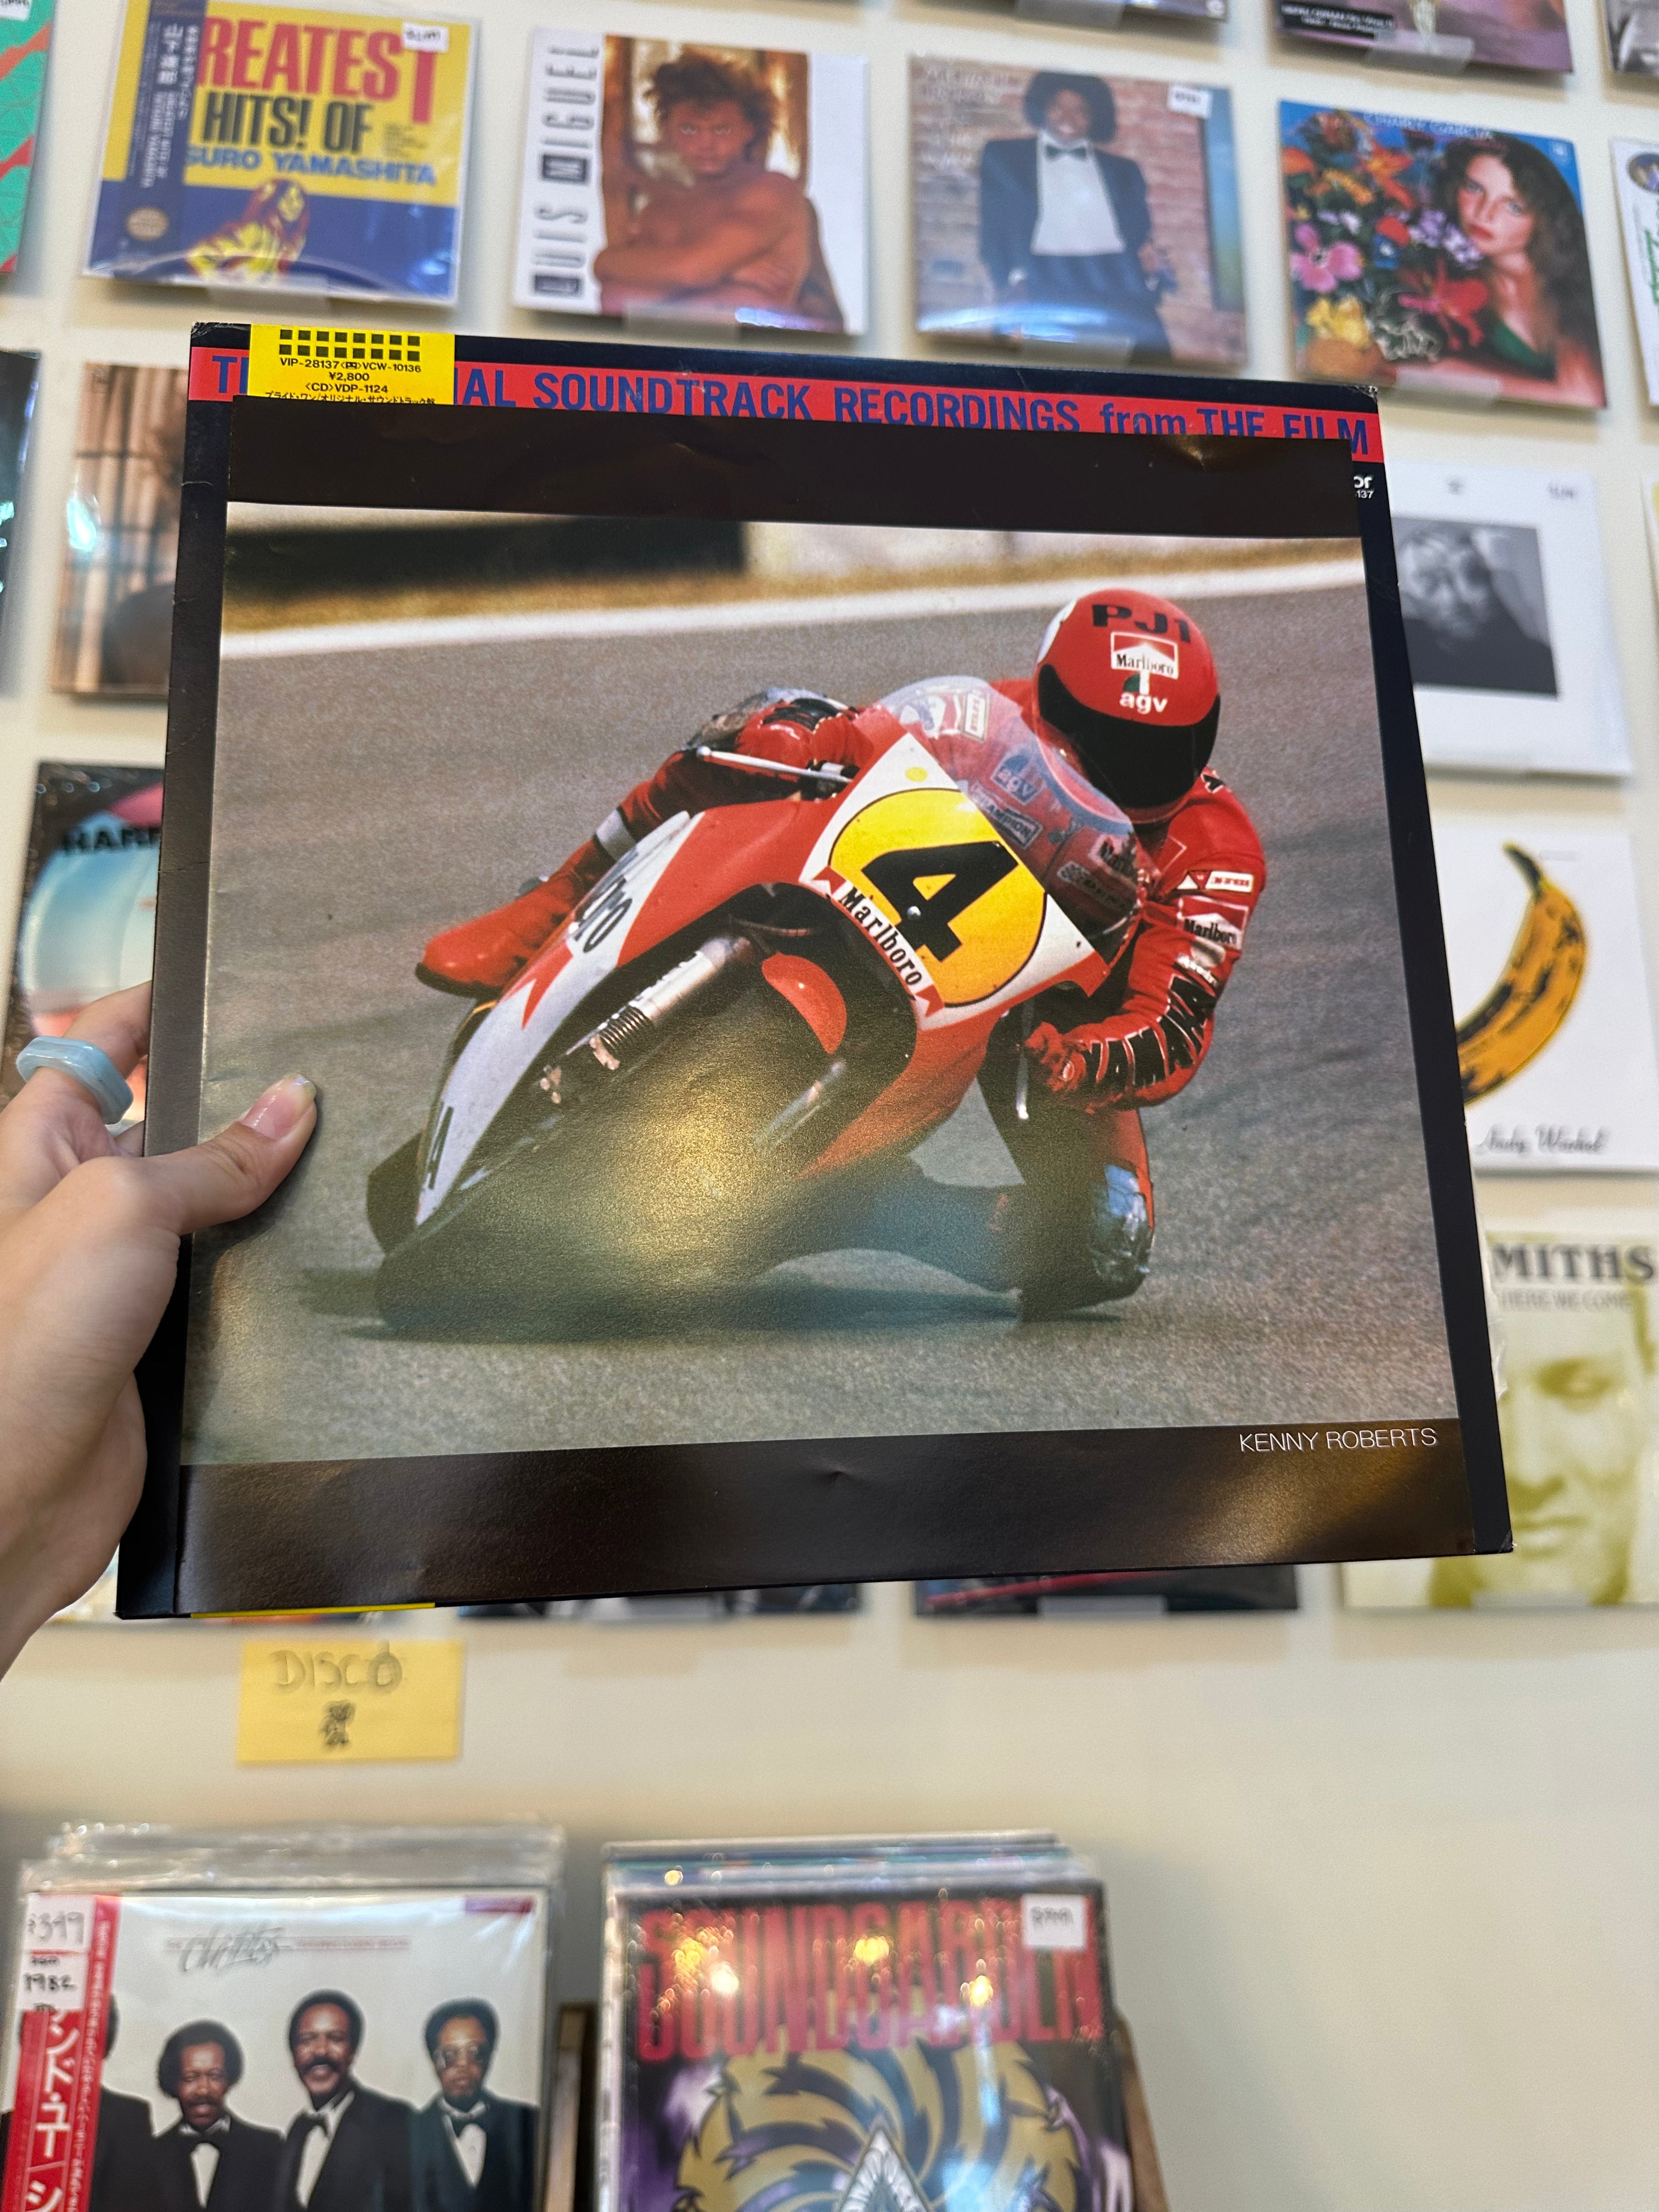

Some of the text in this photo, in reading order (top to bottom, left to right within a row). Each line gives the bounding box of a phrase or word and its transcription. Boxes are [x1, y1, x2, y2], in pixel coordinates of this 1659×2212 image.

[203, 91, 312, 149] HITS!
[323, 100, 375, 154] OF
[272, 151, 436, 185] YAMASHITA
[329, 371, 370, 382] ¥2,800
[454, 367, 516, 407] AL
[533, 372, 812, 421] SOUNDTRACK
[834, 387, 1080, 433] RECORDINGS
[1099, 403, 1187, 435] from
[1116, 653, 1173, 676] Marlboro
[1119, 692, 1168, 714] agv
[996, 768, 1036, 797] agv
[861, 840, 1019, 963] 4
[837, 886, 923, 986] Marlboro
[1493, 1243, 1653, 1283] MITHS
[1239, 1427, 1438, 1452] KENNY ROBERTS
[269, 1644, 405, 1694] DISCO
